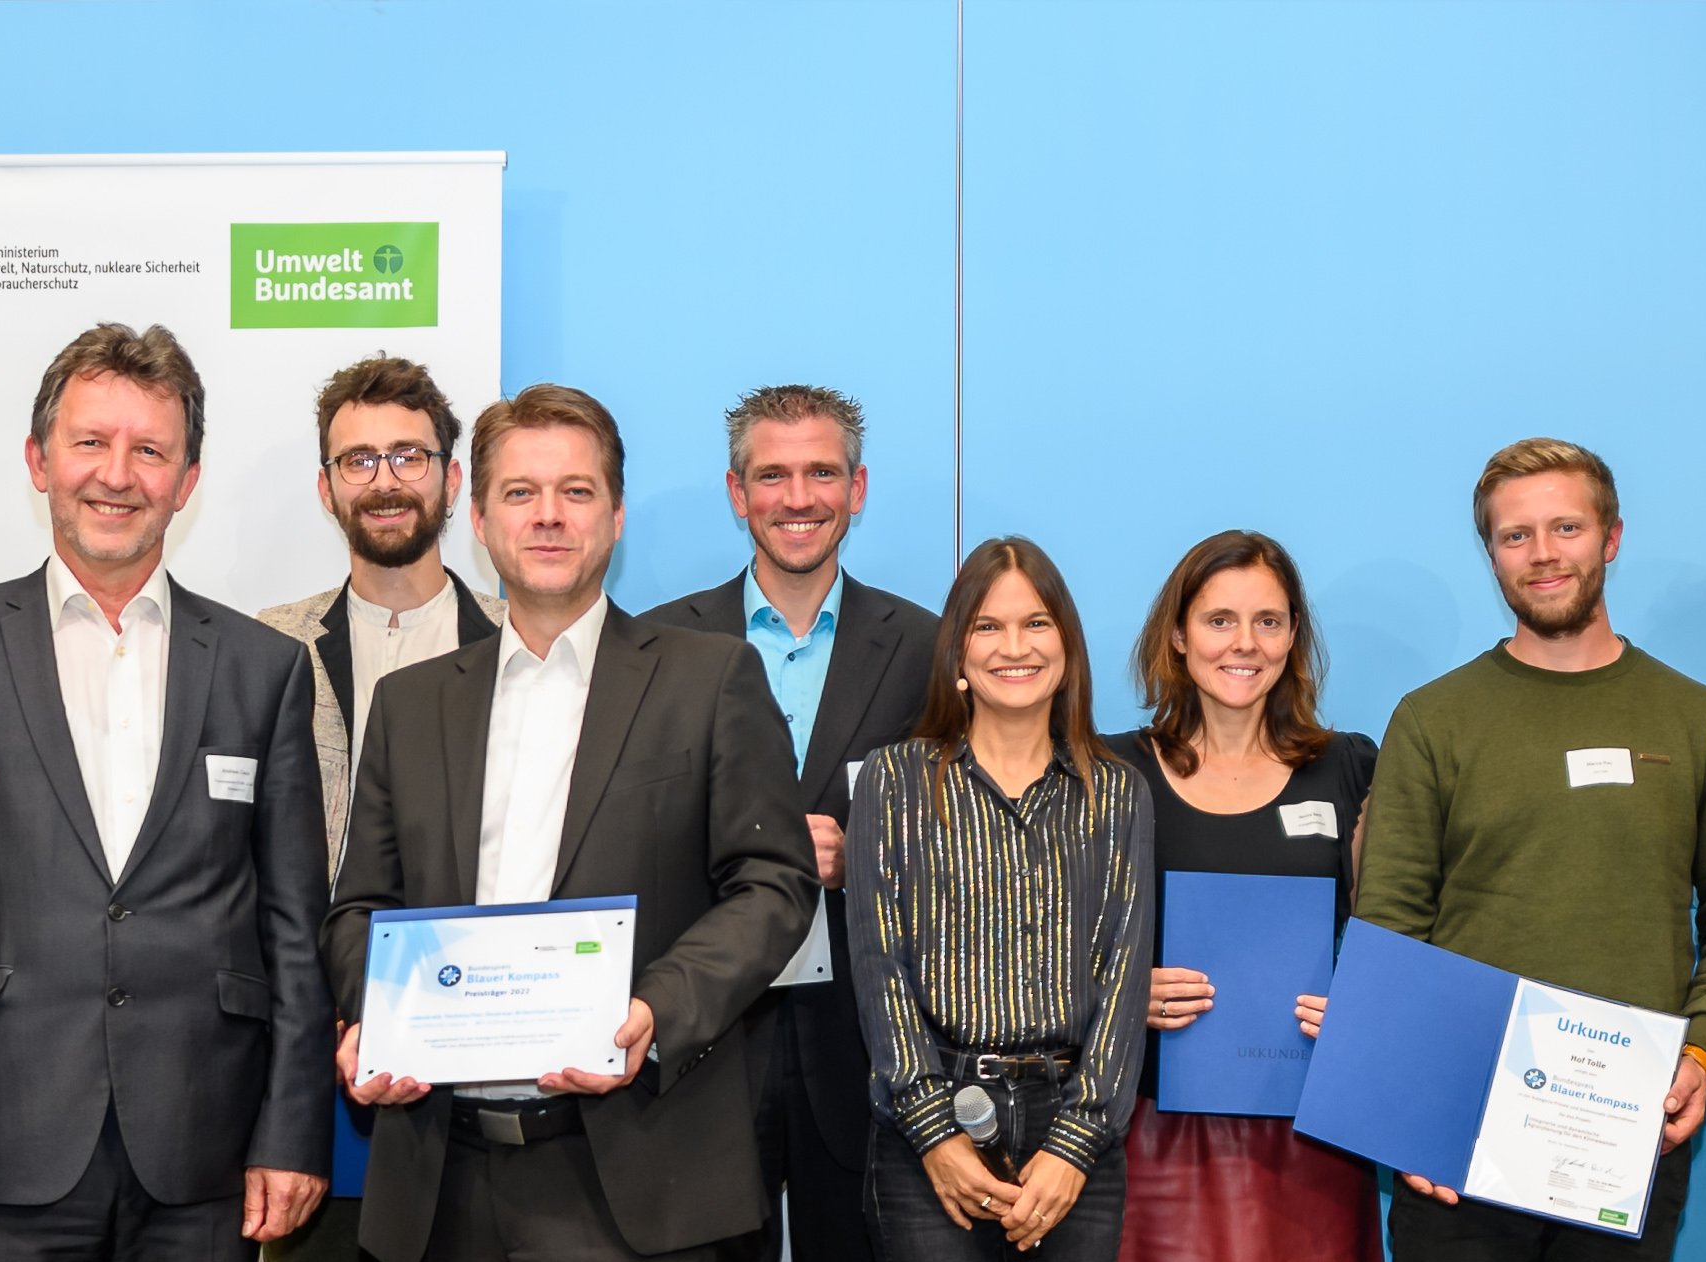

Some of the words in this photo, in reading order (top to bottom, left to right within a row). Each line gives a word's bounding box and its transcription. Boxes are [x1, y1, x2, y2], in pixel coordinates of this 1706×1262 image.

[21, 261, 92, 276] Naturschutz,
[94, 261, 142, 274] nukleare
[145, 260, 201, 274] Sicherheit
[255, 249, 363, 274] Umwelt
[255, 276, 414, 302] Bundesamt
[466, 974, 504, 984] Blauer
[508, 971, 561, 982] Kompass
[1556, 1017, 1632, 1048] Urkunde
[1237, 1048, 1310, 1060] URKUNDE
[1570, 1055, 1586, 1064] Hof
[1550, 1082, 1587, 1099] Blauer
[1589, 1093, 1640, 1112] Kompass
